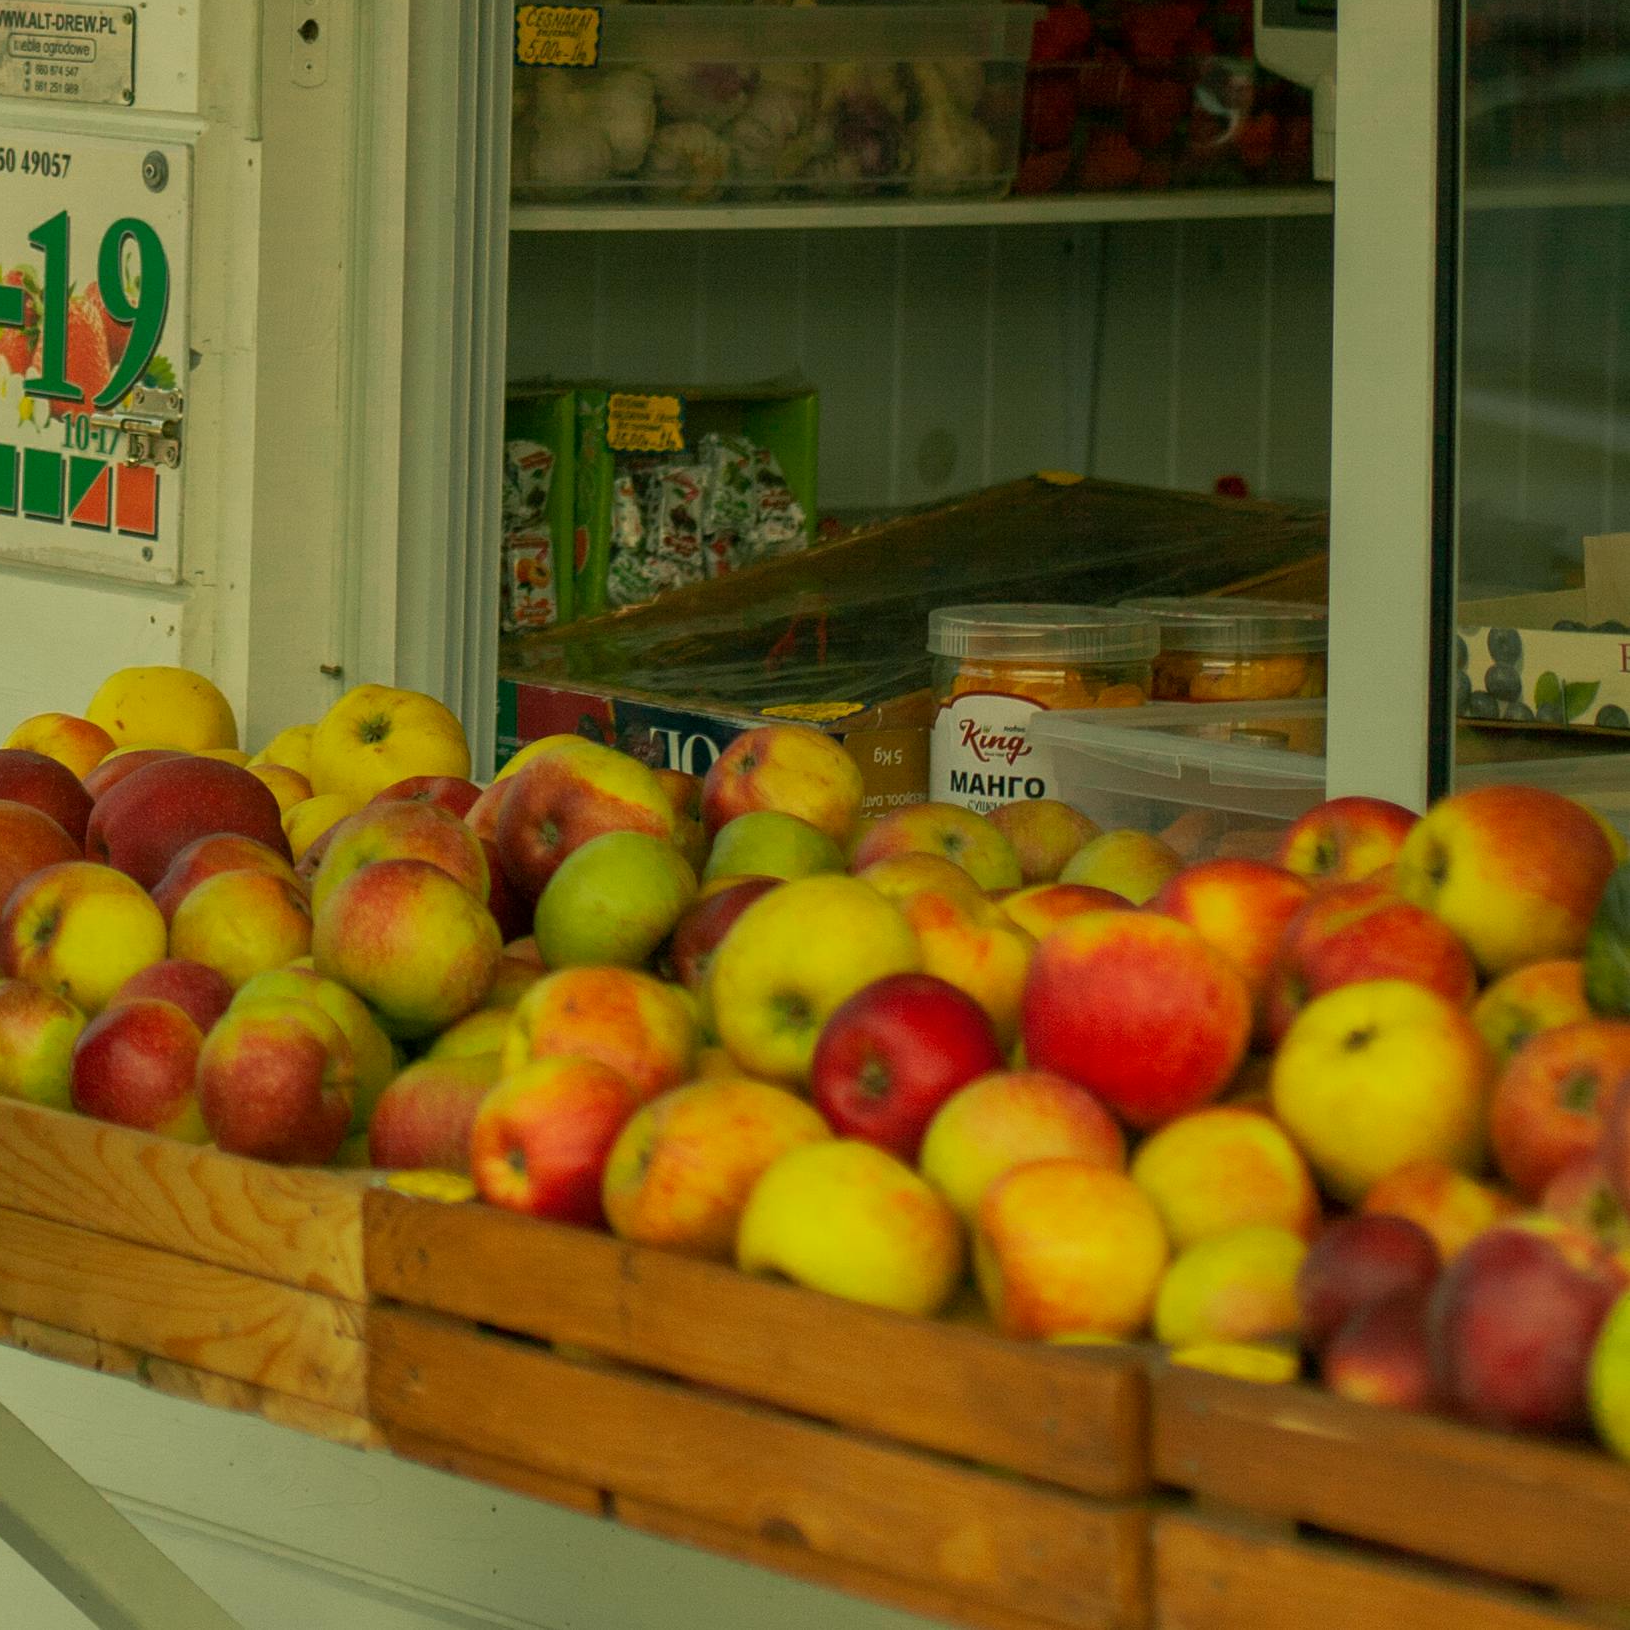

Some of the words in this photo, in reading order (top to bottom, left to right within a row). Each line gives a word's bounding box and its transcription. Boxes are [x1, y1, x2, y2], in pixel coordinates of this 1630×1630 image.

[42, 39, 91, 57] ogrodowe
[20, 150, 72, 179] 49057
[958, 718, 1033, 767] King
[949, 769, 1046, 800] МАНГО
